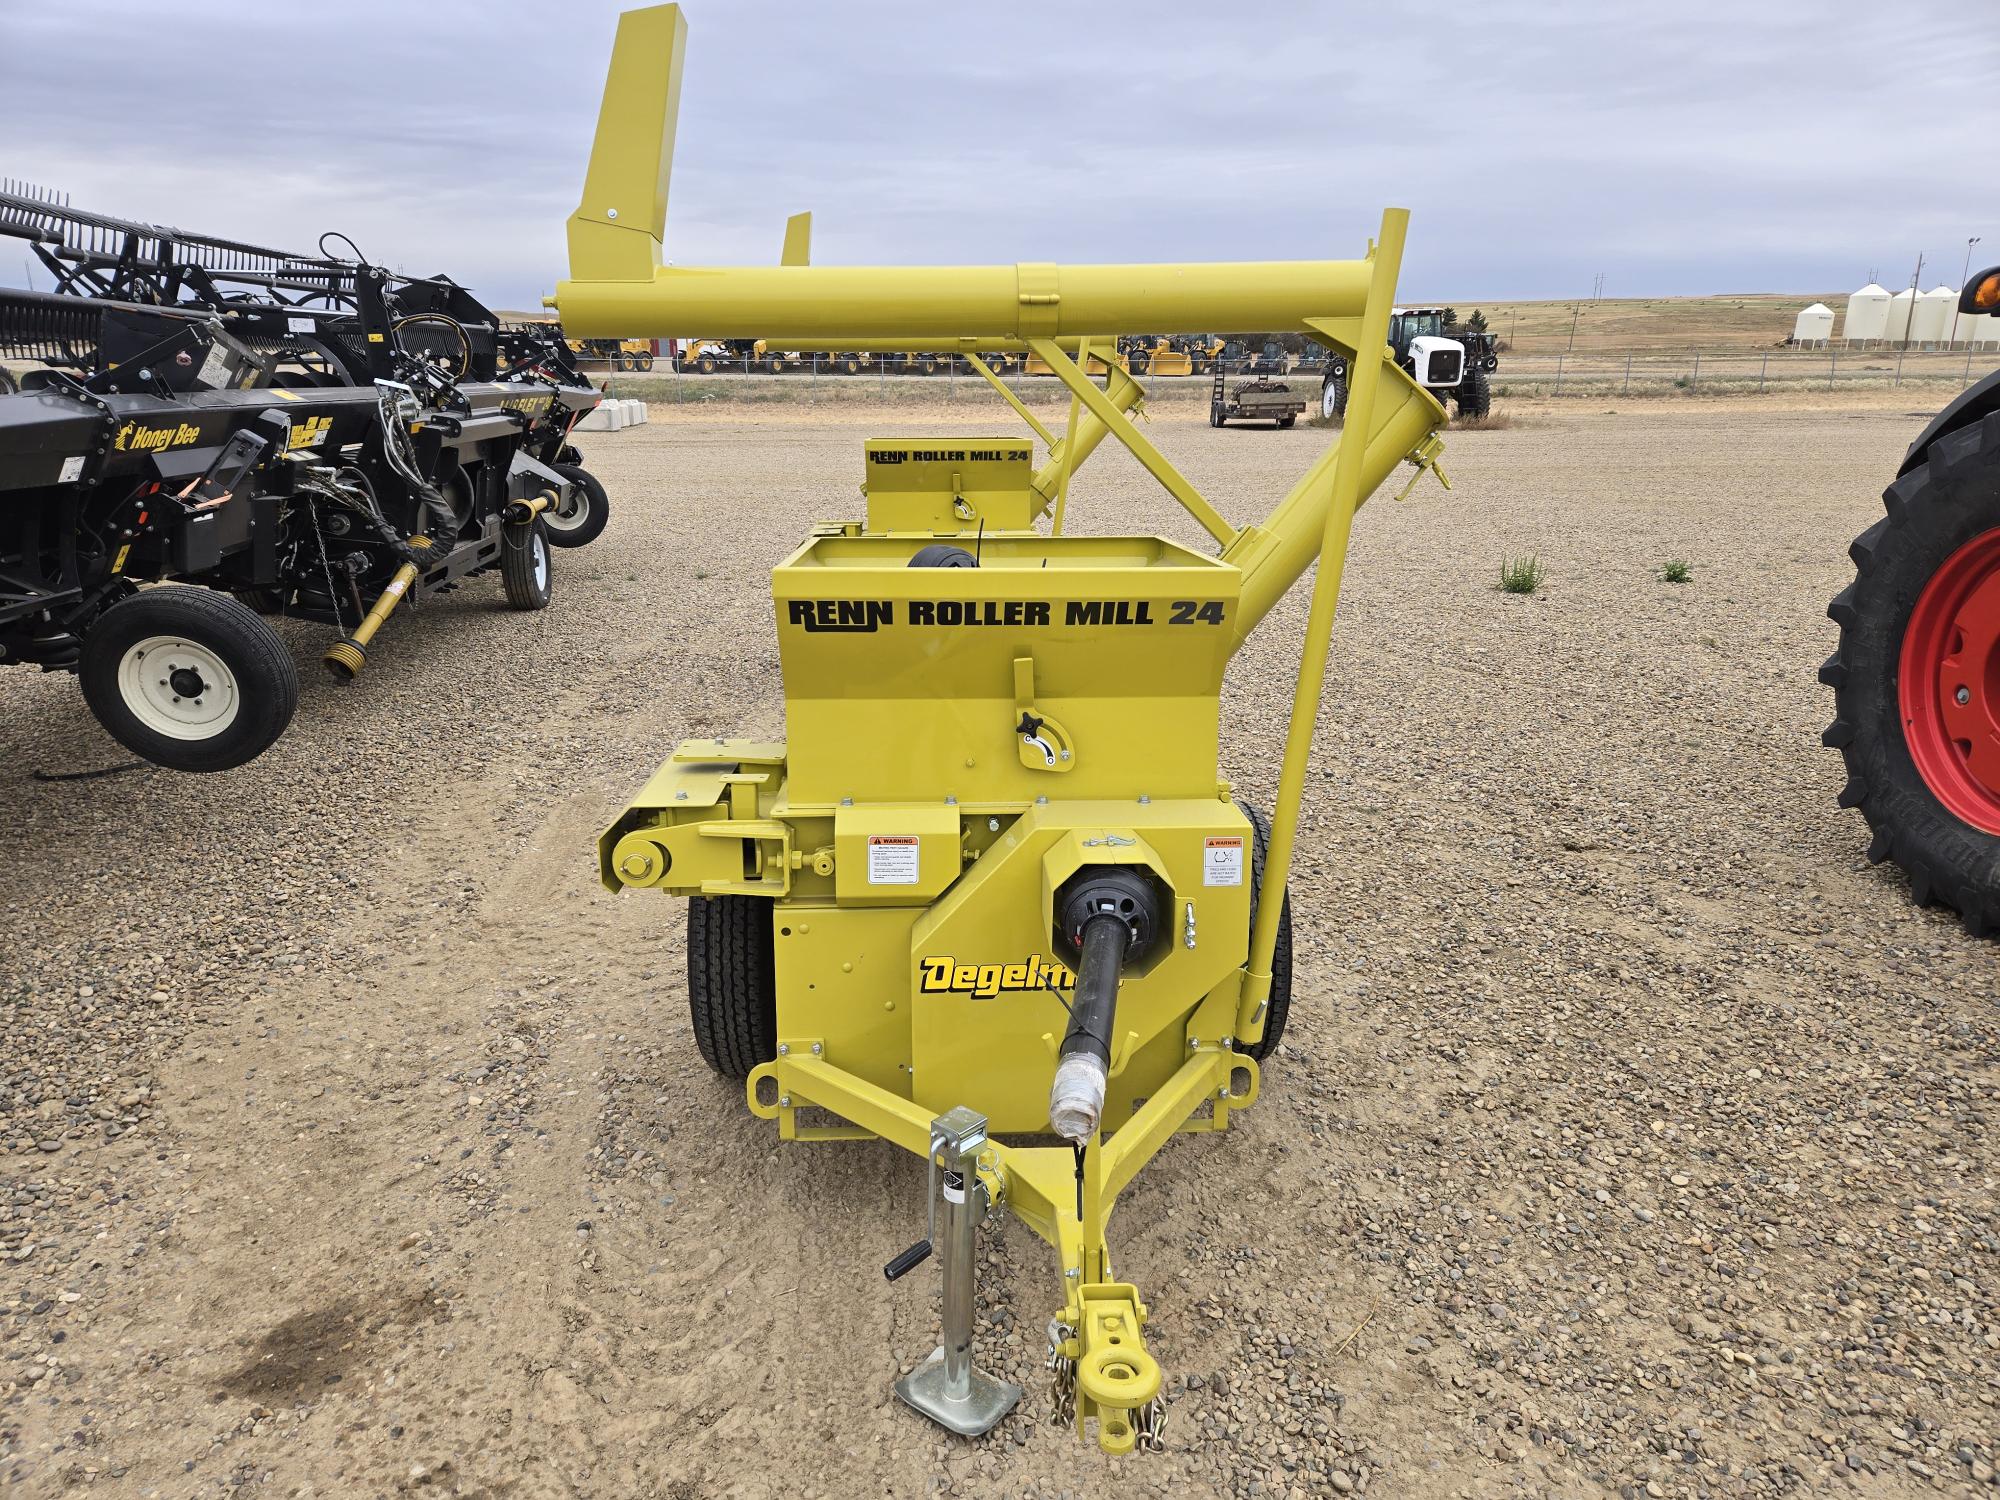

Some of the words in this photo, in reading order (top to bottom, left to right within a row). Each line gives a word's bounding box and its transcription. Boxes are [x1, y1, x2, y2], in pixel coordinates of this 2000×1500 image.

[129, 425, 177, 453] Honey
[172, 423, 201, 446] Bee
[869, 450, 908, 464] RENN
[912, 450, 965, 462] ROLLER
[970, 450, 1003, 461] MILL
[1007, 450, 1029, 461] 24
[788, 600, 894, 633] RENN
[908, 601, 1050, 626] ROLLER
[1065, 601, 1153, 625] MILL
[1168, 601, 1225, 625] 24
